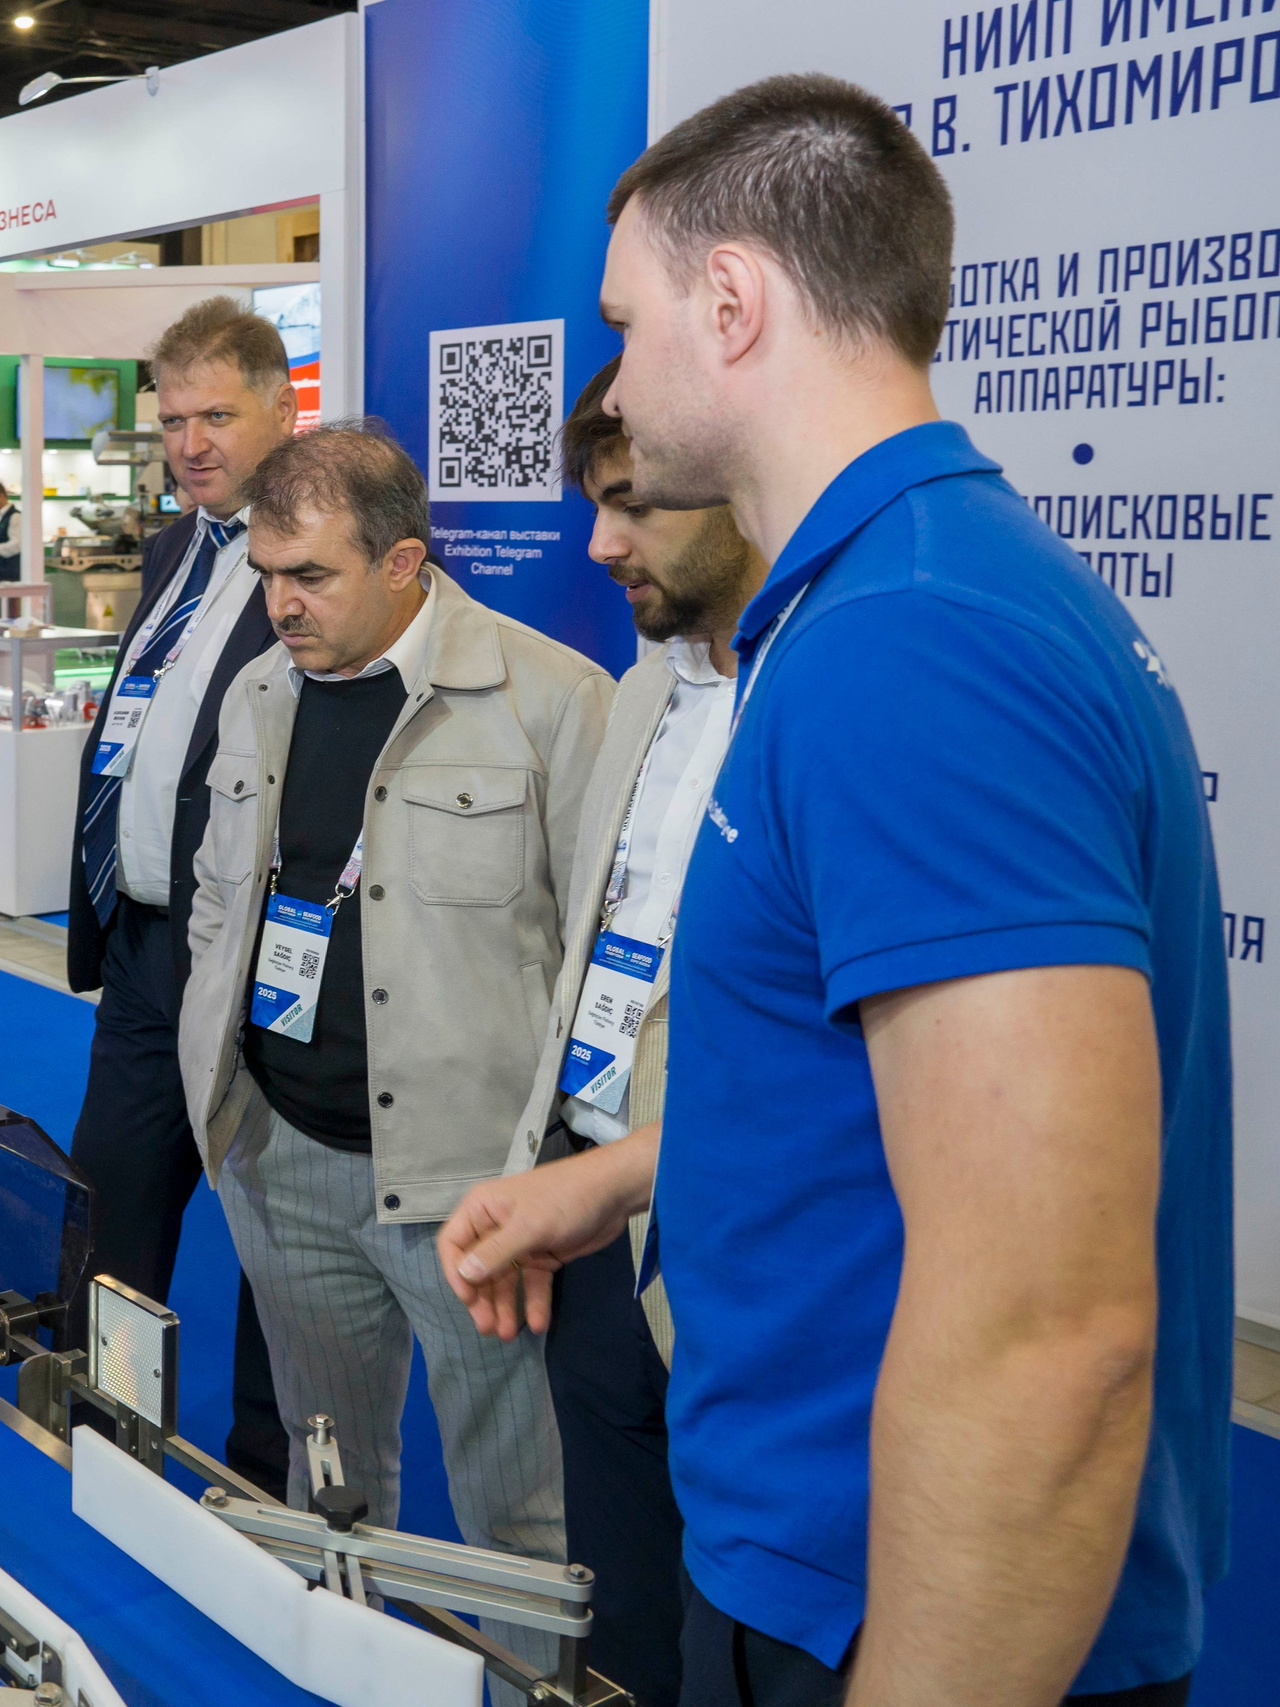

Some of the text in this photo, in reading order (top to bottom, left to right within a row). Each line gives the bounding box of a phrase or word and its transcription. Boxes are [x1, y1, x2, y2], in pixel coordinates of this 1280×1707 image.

[942, 0, 1072, 79] НИИП
[932, 30, 1280, 157] В. ТИХОМИРО
[1057, 252, 1079, 298] И
[1098, 229, 1280, 294] ПРОИЗВО
[974, 357, 1225, 414] АППАРАТУРЫ:
[1023, 494, 1274, 541] ПОИСКОВЫЕ
[430, 526, 561, 541] Telegram-канал выставки
[444, 544, 542, 561] Exhibition Telegram
[471, 562, 514, 575] Channel
[257, 986, 277, 1000] 2025
[280, 1004, 303, 1026] VISITOR
[571, 1044, 592, 1061] 2025
[590, 1066, 617, 1094] VISITOR
